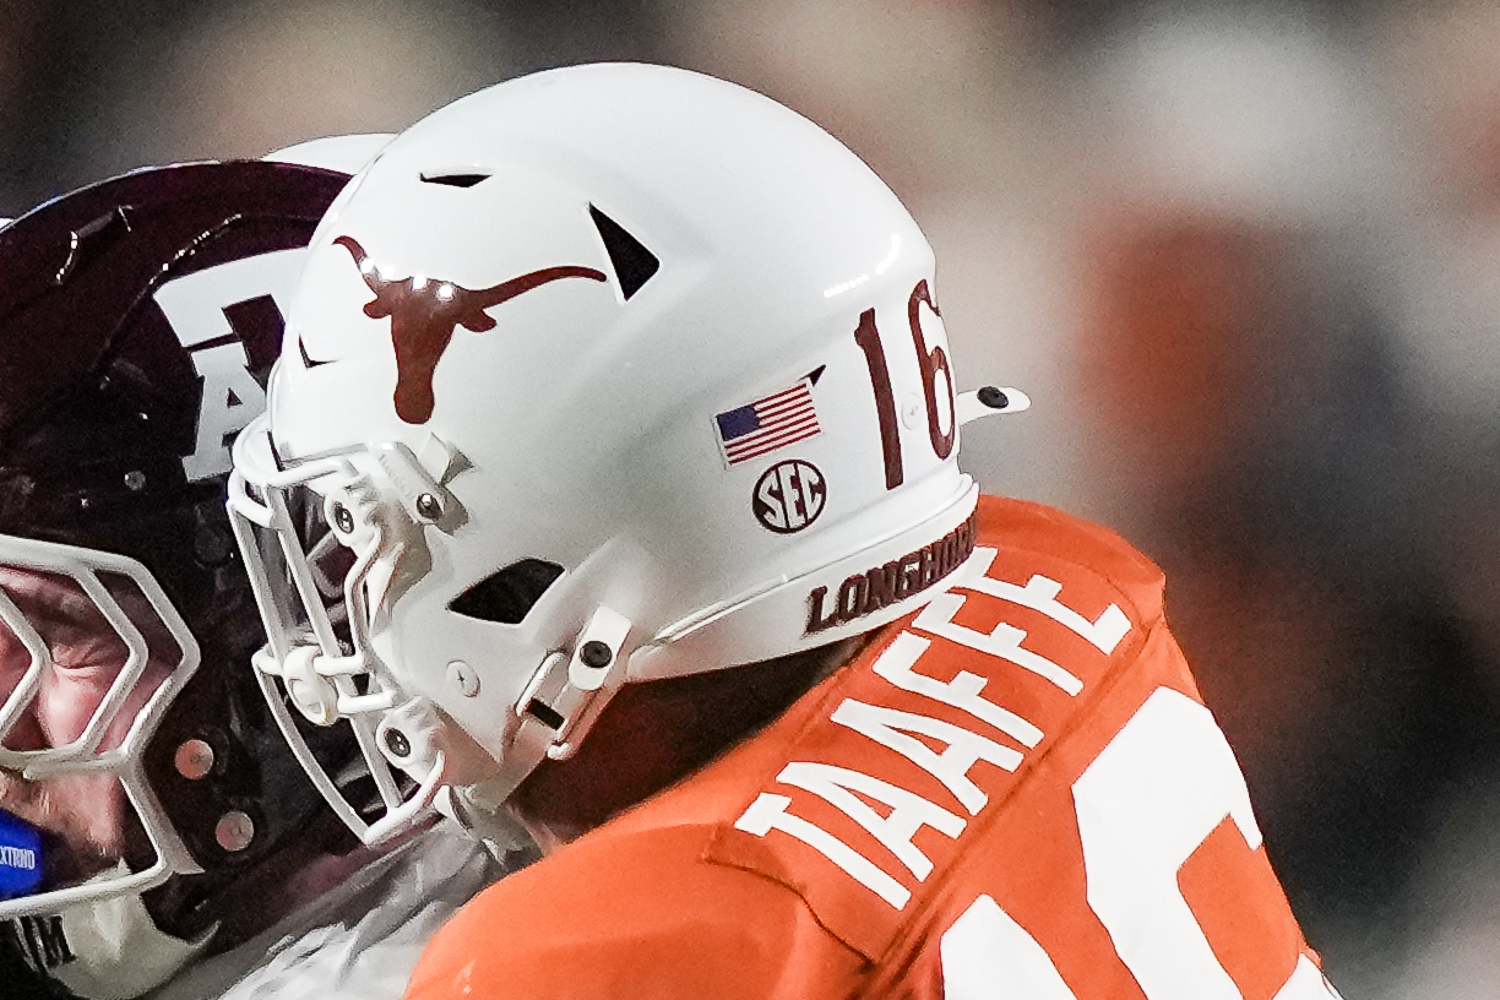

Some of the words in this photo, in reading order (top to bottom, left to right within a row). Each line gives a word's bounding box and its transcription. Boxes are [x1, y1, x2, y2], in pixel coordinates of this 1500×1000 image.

[853, 278, 956, 491] 16
[754, 460, 826, 532] SEC
[733, 546, 1132, 912] TAAFFE
